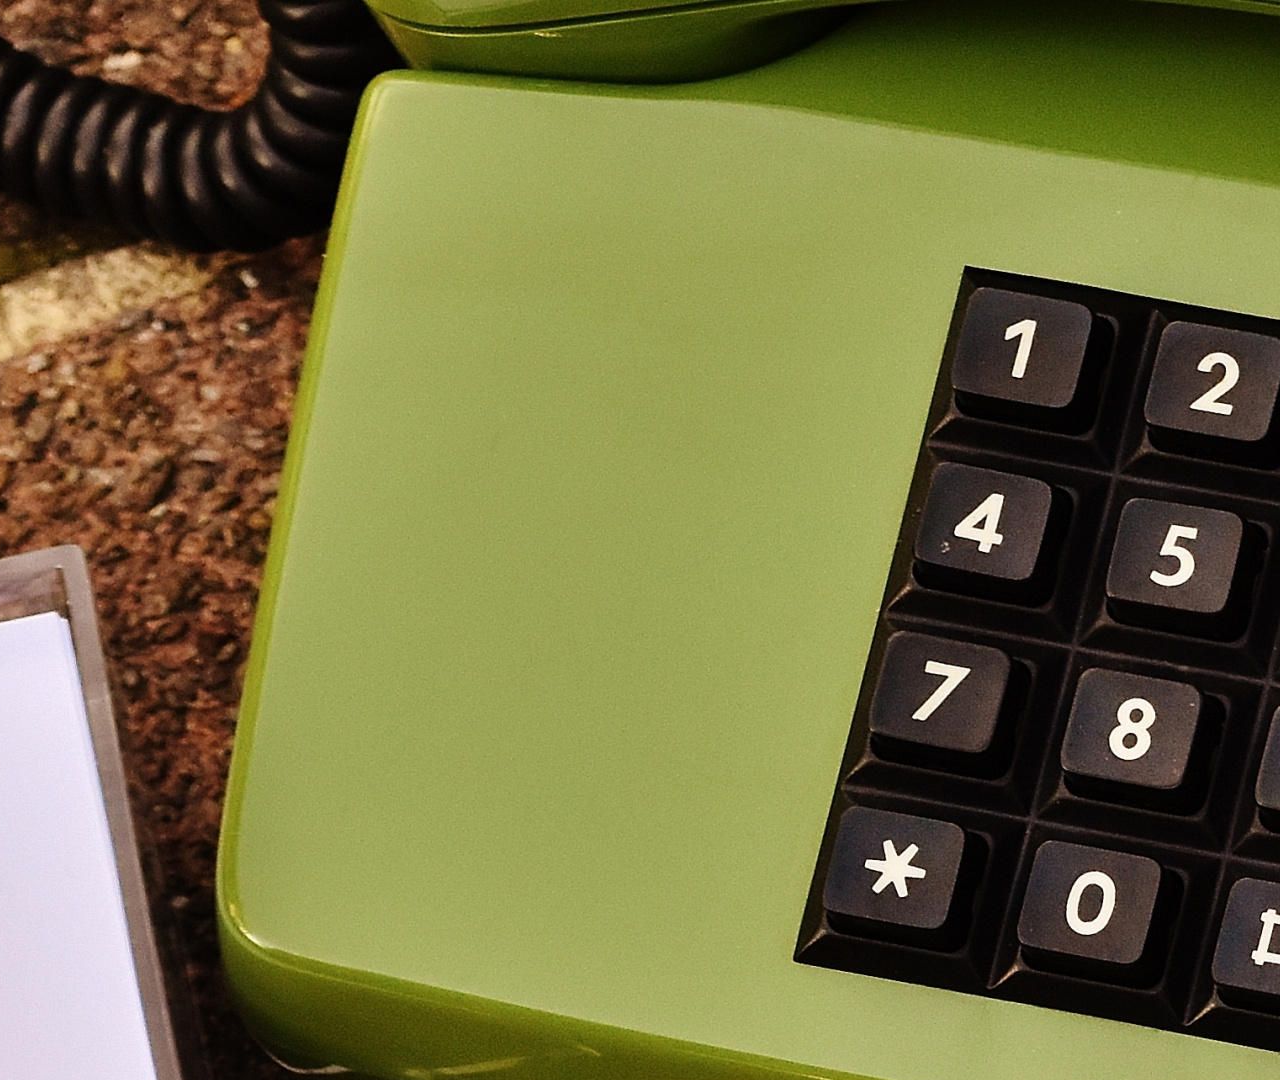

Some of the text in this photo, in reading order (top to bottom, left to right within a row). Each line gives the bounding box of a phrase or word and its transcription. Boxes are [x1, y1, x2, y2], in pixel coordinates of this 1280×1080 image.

[1004, 319, 1037, 379] 1
[1189, 352, 1240, 416] 2
[953, 493, 1005, 554] 4
[1149, 524, 1198, 587] 5
[911, 660, 971, 721] 7
[1108, 697, 1157, 761] 8
[1065, 870, 1116, 936] 0
